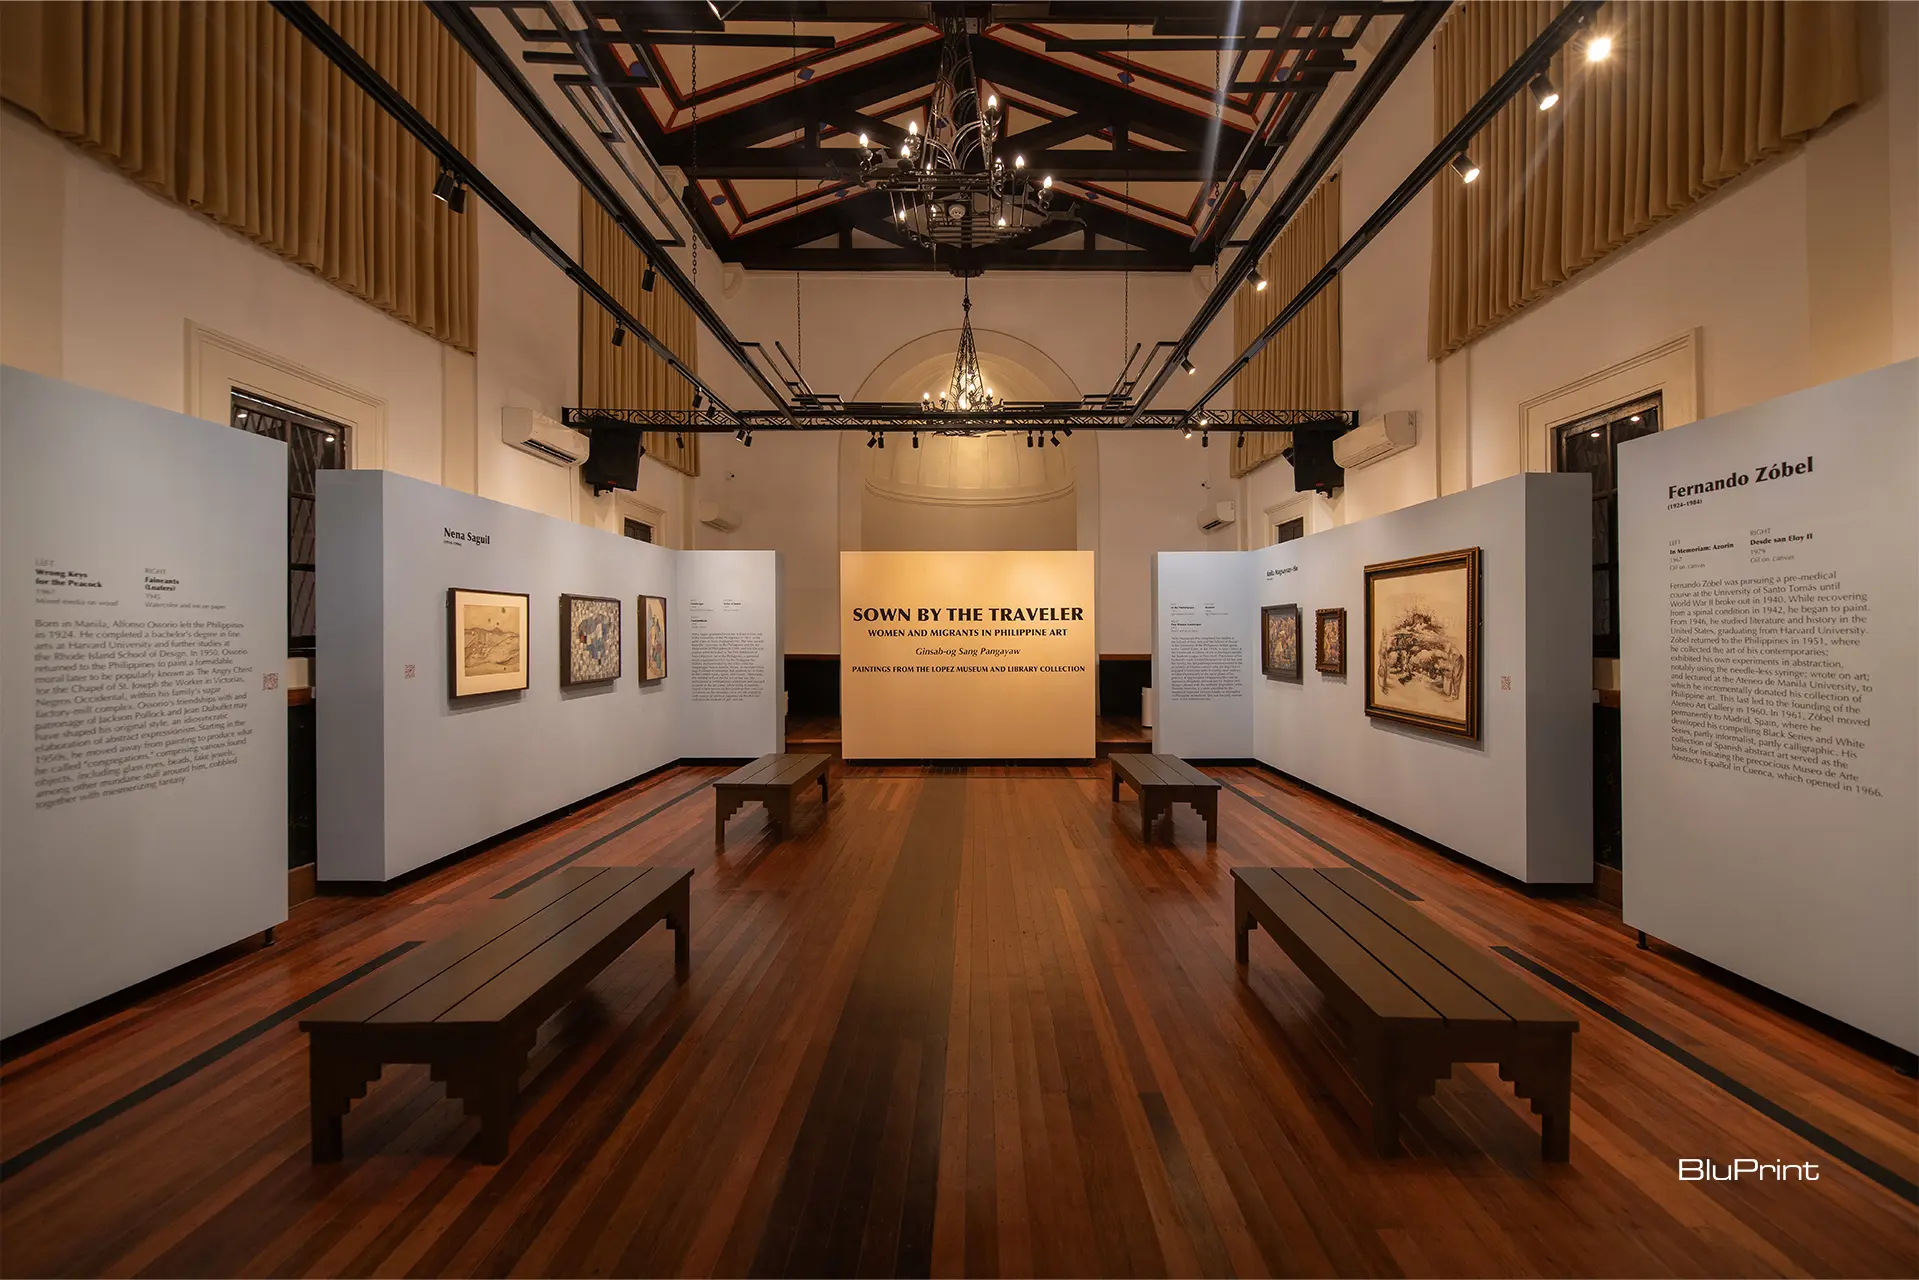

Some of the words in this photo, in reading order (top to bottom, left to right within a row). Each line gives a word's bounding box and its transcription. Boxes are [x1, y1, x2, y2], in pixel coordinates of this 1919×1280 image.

[1668, 472, 1749, 500] Fernando
[1755, 456, 1813, 483] Zóbel
[444, 527, 465, 540] Nena
[467, 531, 490, 546] Saguil
[1677, 546, 1711, 554] Memoriam:
[35, 569, 65, 578] Wrong
[68, 571, 88, 579] Keys
[1670, 581, 1700, 589] Fernando
[1702, 579, 1722, 588] Zóbel
[1740, 577, 1774, 587] pursuing
[1784, 570, 1837, 584] pre-medical
[68, 580, 102, 588] Peacock
[1701, 589, 1712, 597] the
[1714, 588, 1750, 597] University
[1753, 586, 1761, 594] of
[1820, 582, 1840, 590] until
[1715, 598, 1736, 606] broke
[1763, 596, 1786, 604] 1940.
[1788, 595, 1814, 603] While
[1817, 593, 1868, 603] recovering
[853, 607, 911, 621] SOWN
[918, 608, 942, 621] BY
[946, 608, 983, 621] THE
[988, 608, 1084, 621] TRAVELER
[1692, 608, 1713, 617] spinal
[1763, 606, 1786, 614] 1942,
[1800, 604, 1828, 615] began
[1842, 604, 1870, 614] paint.
[1690, 618, 1708, 626] 1946,
[1788, 616, 1804, 624] and
[1806, 615, 1837, 625] history
[1840, 615, 1848, 623] in
[1852, 614, 1867, 623] the
[868, 629, 905, 637] WOMEN
[907, 629, 928, 637] AND
[930, 629, 979, 637] MIGRANTS
[1718, 627, 1758, 636] graduating
[1760, 626, 1778, 634] from
[1780, 626, 1815, 634] Harvard
[1818, 626, 1868, 636] University.
[1670, 636, 1690, 644] Zóbel
[1744, 636, 1788, 646] Philippines
[1803, 638, 1828, 646] 1951,
[1831, 637, 1860, 646] where
[916, 647, 956, 657] Ginsab-og
[958, 648, 978, 657] Sang
[980, 647, 1021, 657] Pangayaw
[1712, 646, 1724, 654] the
[1738, 646, 1746, 654] of
[1732, 656, 1779, 666] experiments
[1782, 658, 1790, 666] in
[1792, 658, 1844, 670] abstraction,
[1670, 664, 1695, 672] notably
[1696, 666, 1715, 674] using
[1730, 667, 1772, 675] needle-less
[1838, 672, 1851, 680] on
